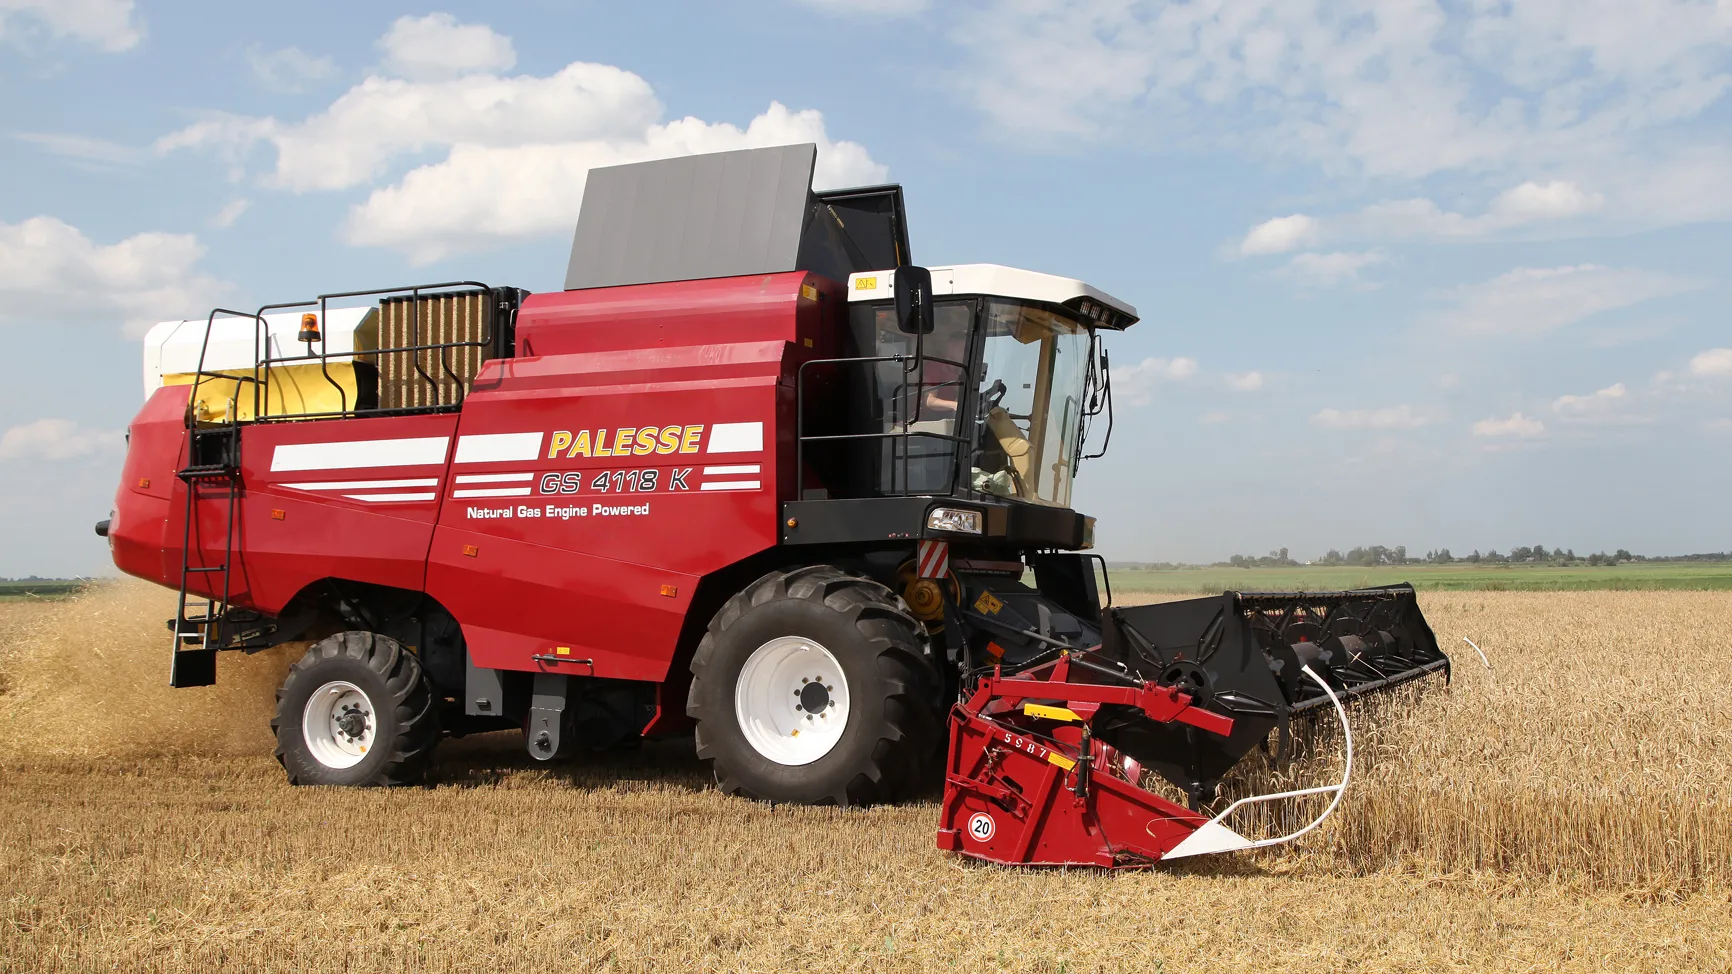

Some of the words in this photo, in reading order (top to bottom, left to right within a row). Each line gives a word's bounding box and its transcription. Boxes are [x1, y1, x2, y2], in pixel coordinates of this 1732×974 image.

[547, 424, 705, 459] PALESSE
[539, 472, 582, 495] GS
[591, 469, 659, 493] 4118
[669, 468, 693, 491] K
[467, 505, 513, 519] Natural
[517, 505, 541, 518] Gas
[545, 504, 588, 520] Engine
[592, 502, 650, 517] Powered
[974, 819, 990, 835] 20
